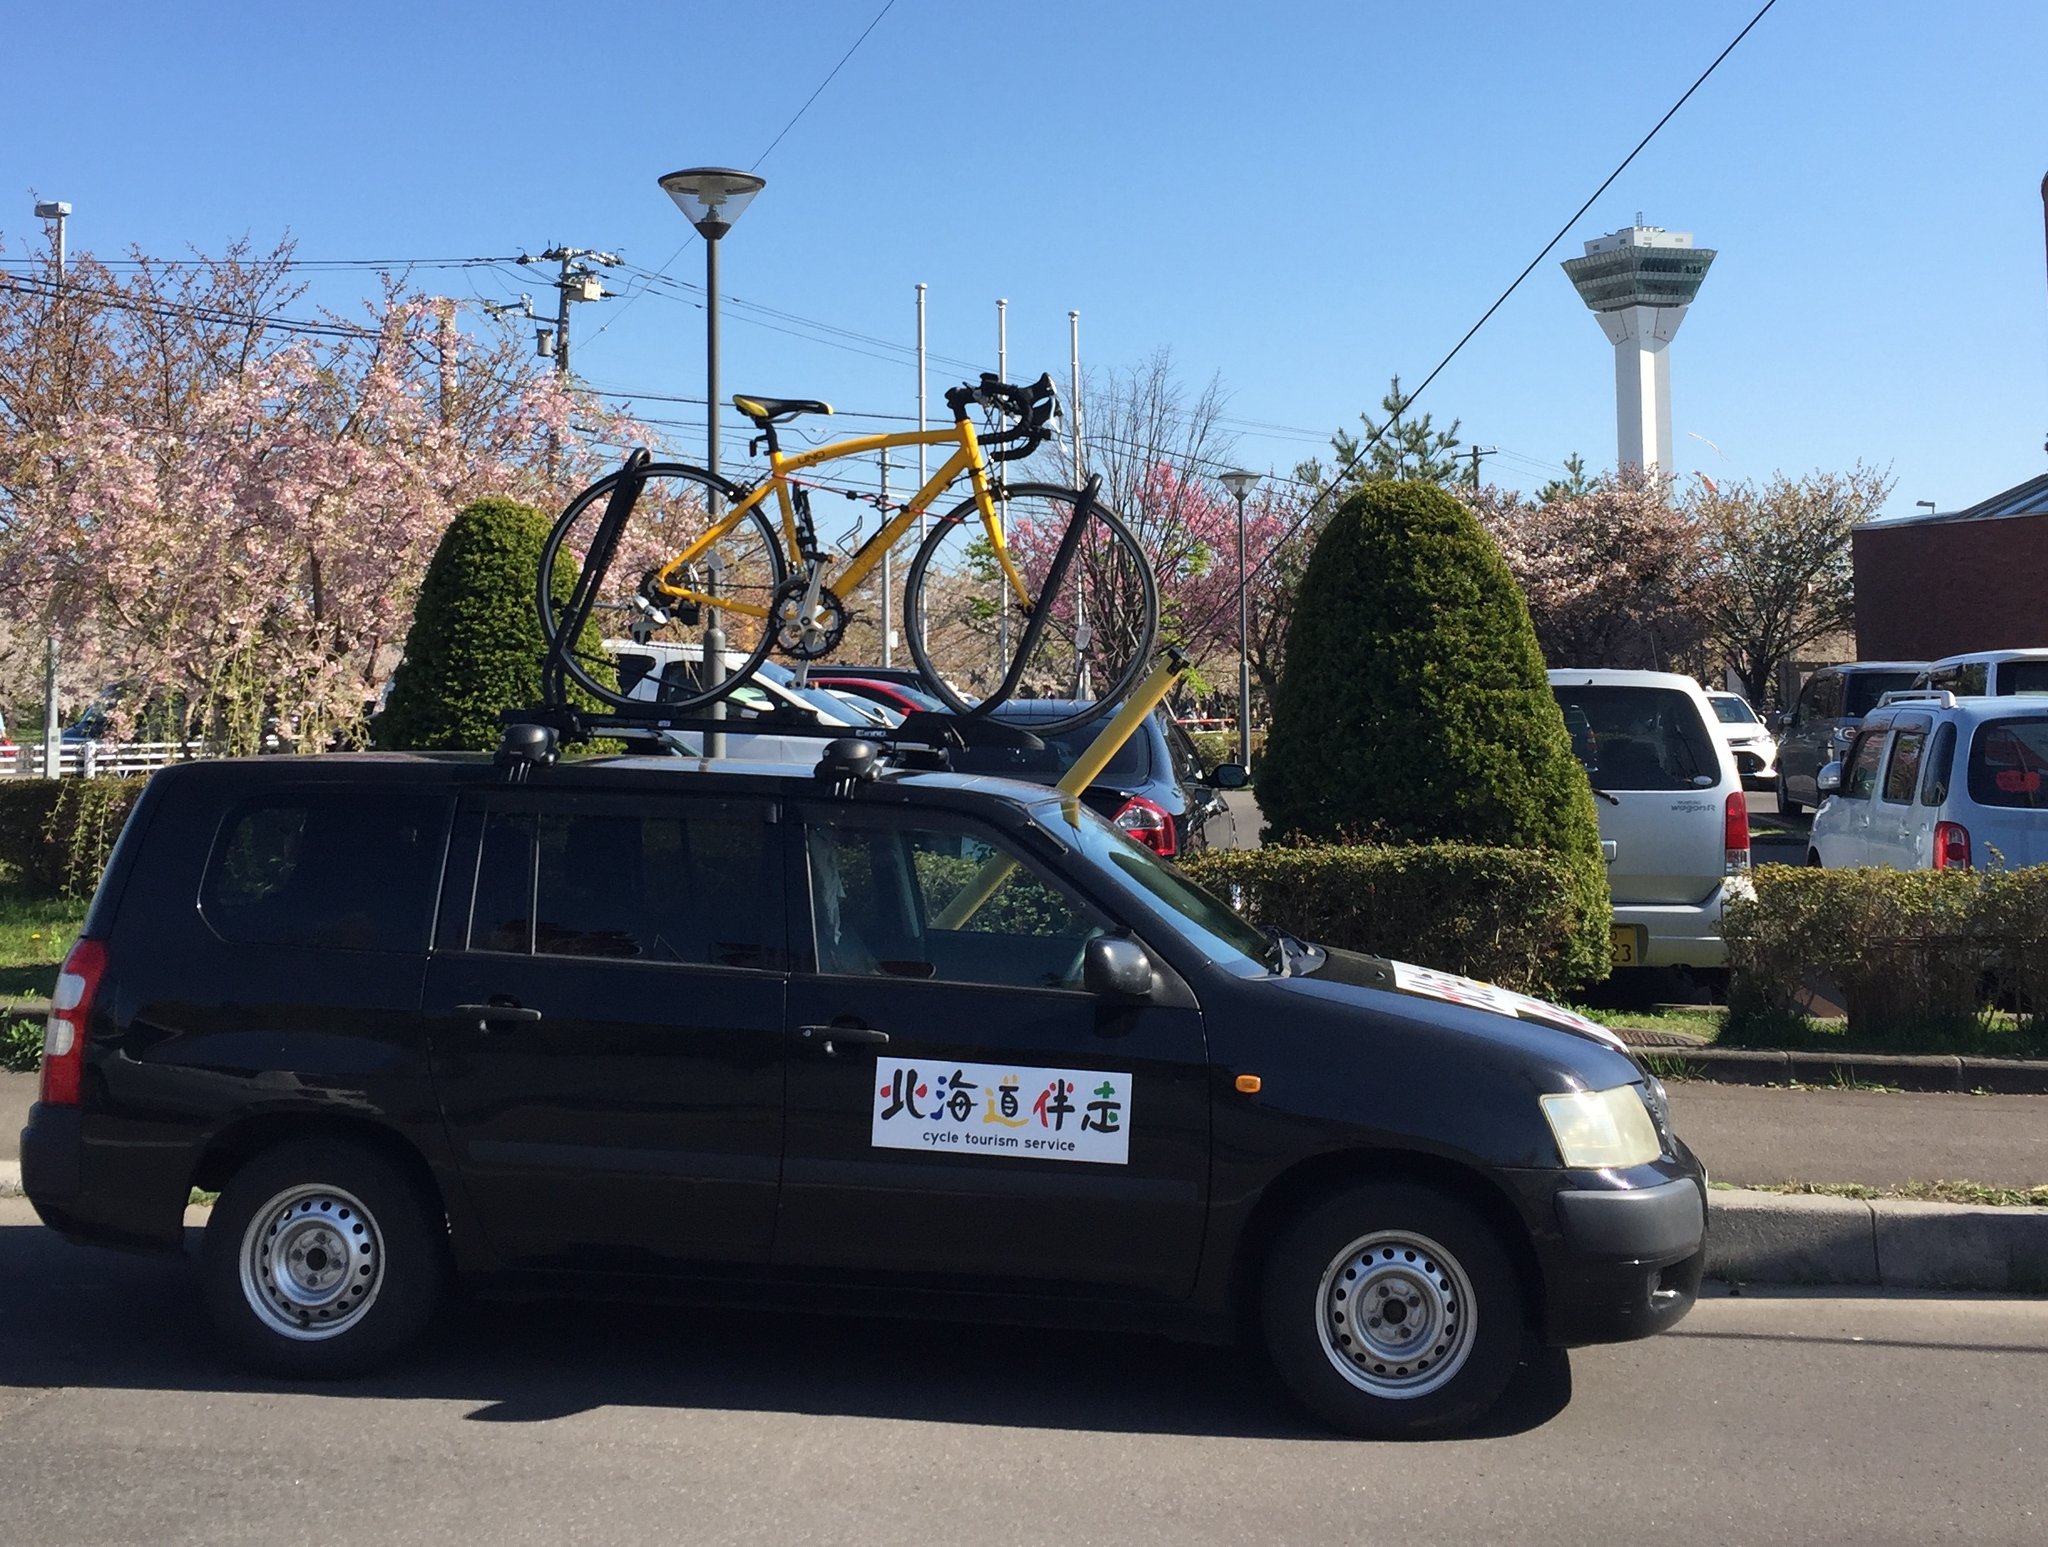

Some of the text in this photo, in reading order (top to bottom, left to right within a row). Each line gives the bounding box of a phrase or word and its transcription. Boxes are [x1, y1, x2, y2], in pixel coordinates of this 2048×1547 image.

[880, 1069, 1122, 1133] 北海道伴走
[922, 1131, 1076, 1152] cycle tourism service
